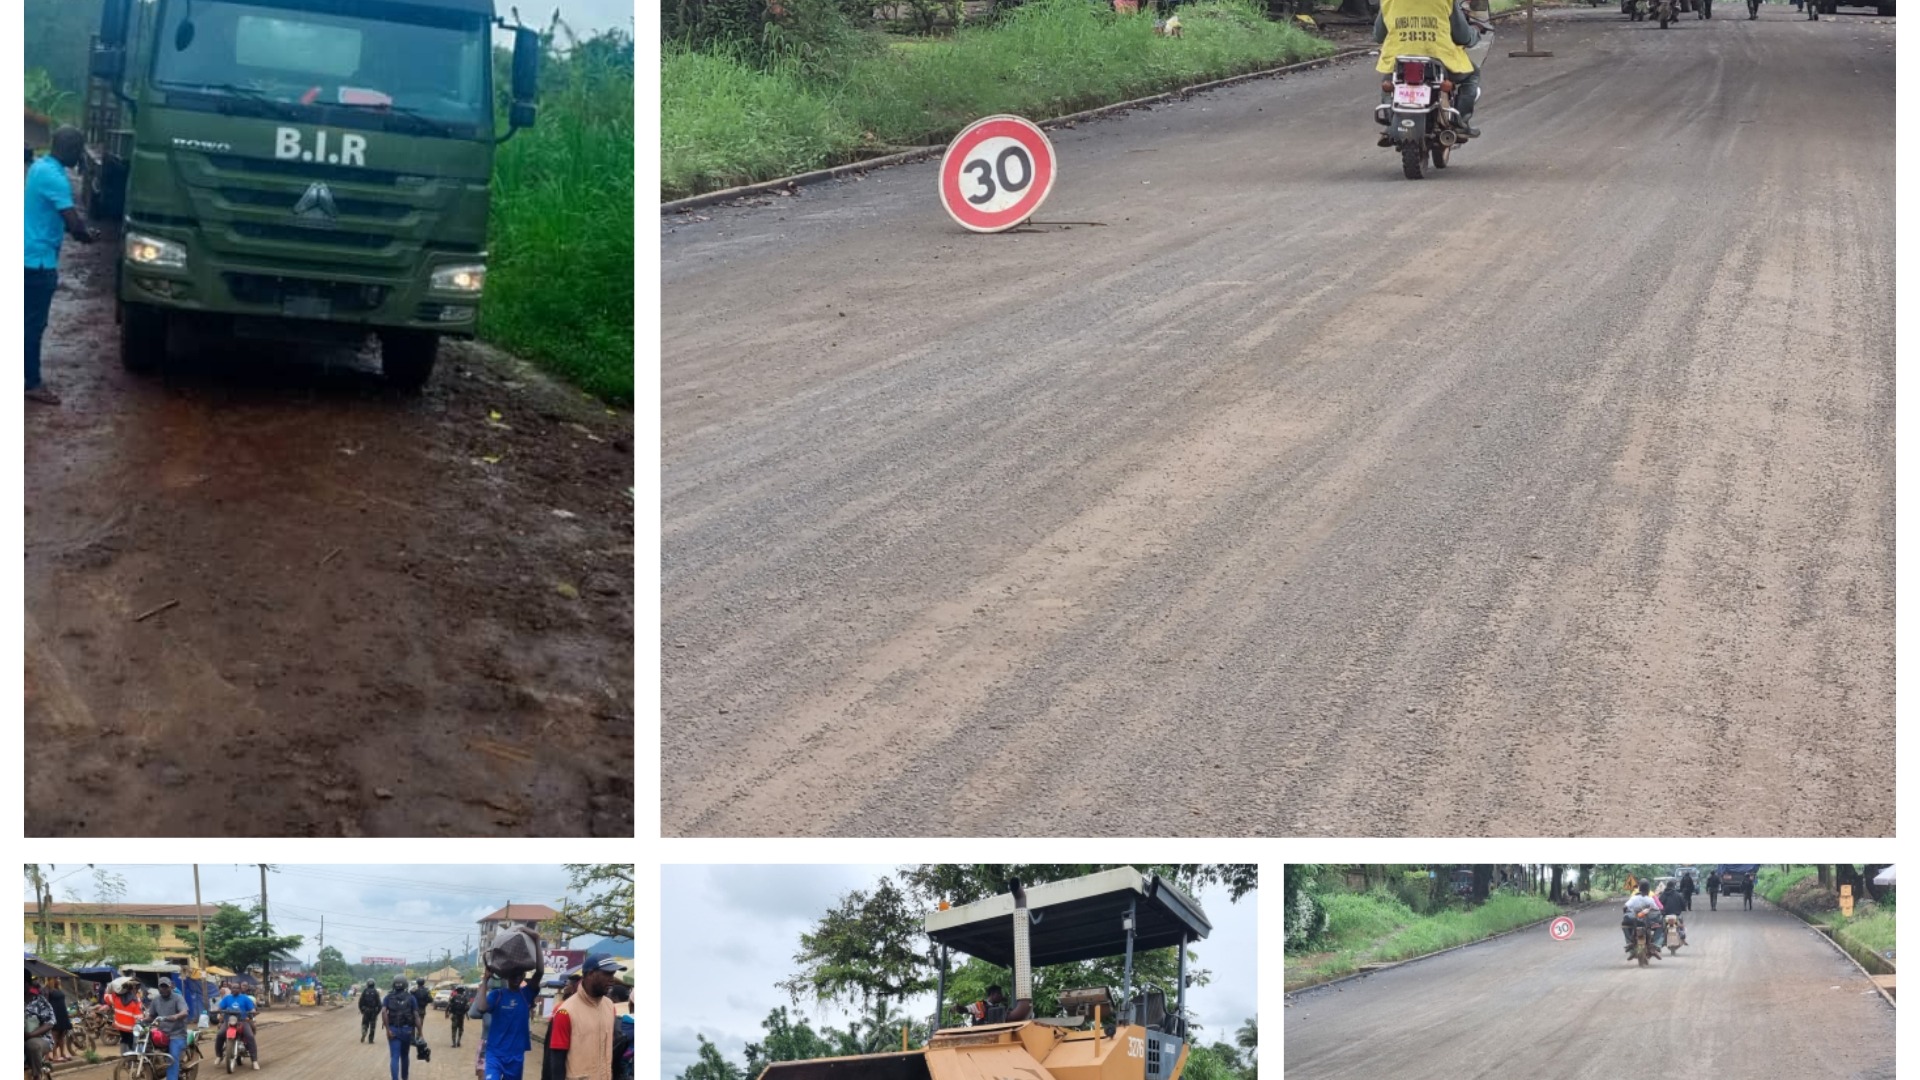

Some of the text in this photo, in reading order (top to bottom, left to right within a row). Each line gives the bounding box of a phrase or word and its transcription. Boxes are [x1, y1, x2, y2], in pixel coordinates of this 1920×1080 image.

[1410, 16, 1420, 28] CITY
[1420, 16, 1438, 28] COUNCIL
[1399, 31, 1436, 42] 2833
[275, 127, 366, 166] B.I.R
[963, 146, 1032, 205] 30
[1555, 922, 1569, 935] 30
[1127, 1036, 1144, 1058] 3276
